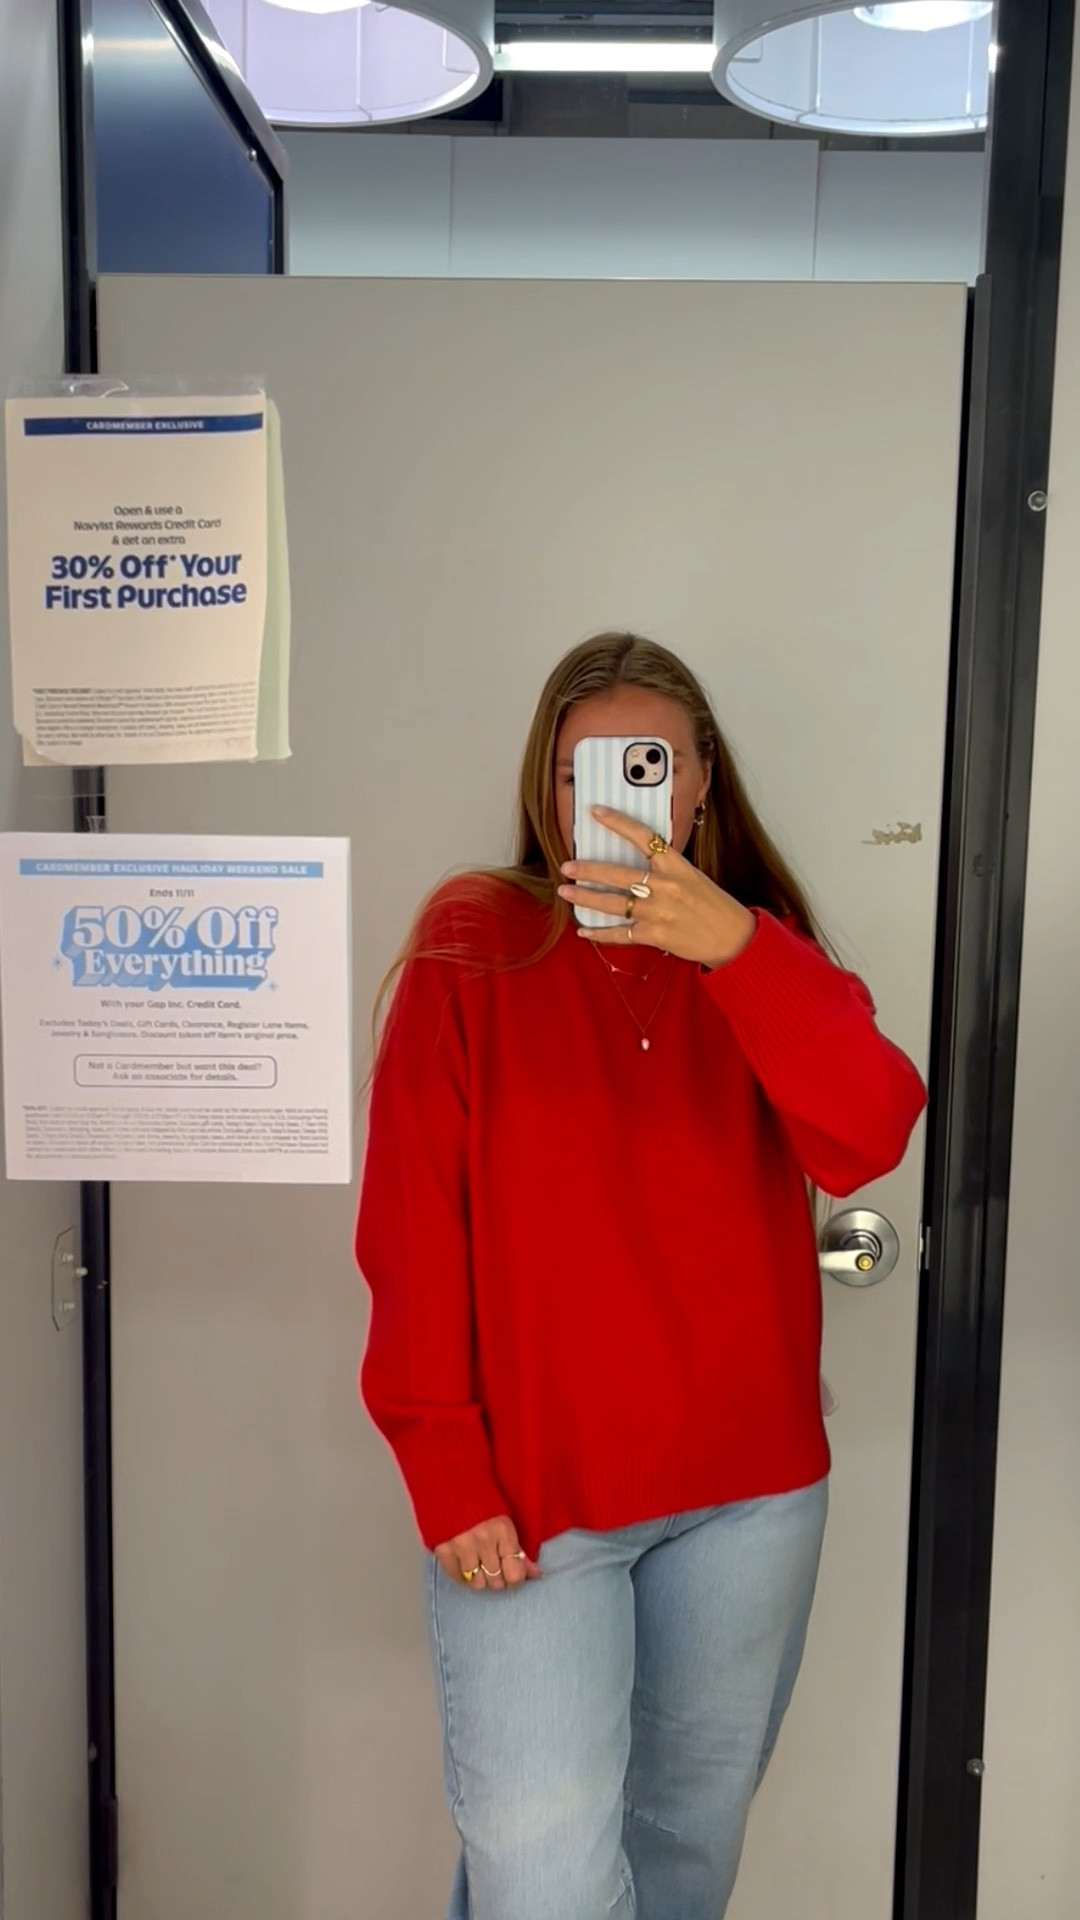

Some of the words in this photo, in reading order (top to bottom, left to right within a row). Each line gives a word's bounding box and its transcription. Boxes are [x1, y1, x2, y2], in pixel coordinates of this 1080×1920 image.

[86, 420, 153, 430] CARDMEMBER
[155, 419, 204, 430] EXCLUSIVE
[114, 505, 142, 516] Open
[155, 506, 174, 515] use
[116, 520, 162, 530] Rewards
[164, 519, 196, 530] Credit
[198, 518, 222, 529] Card
[122, 536, 140, 546] get
[142, 536, 156, 545] an
[158, 535, 186, 545] extra
[51, 555, 115, 580] 30%
[180, 553, 242, 578] Your
[45, 585, 111, 609] First
[117, 582, 247, 609] Purchase
[35, 862, 110, 873] CARDMEMBER
[113, 863, 169, 874] EXCLUSIVE
[226, 864, 278, 875] WEEKEND
[281, 865, 307, 875] SALE
[149, 888, 174, 898] Ends
[176, 888, 195, 898] 11/11
[70, 905, 188, 950] 50%
[196, 905, 279, 950] Off
[83, 949, 268, 981] Everything
[100, 1000, 122, 1009] With
[124, 1001, 145, 1010] your
[147, 1001, 166, 1010] Gap
[187, 1001, 215, 1009] Credit
[88, 1062, 105, 1070] Not
[176, 1062, 192, 1071] but
[218, 1063, 235, 1071] this
[112, 1072, 129, 1081] Ask
